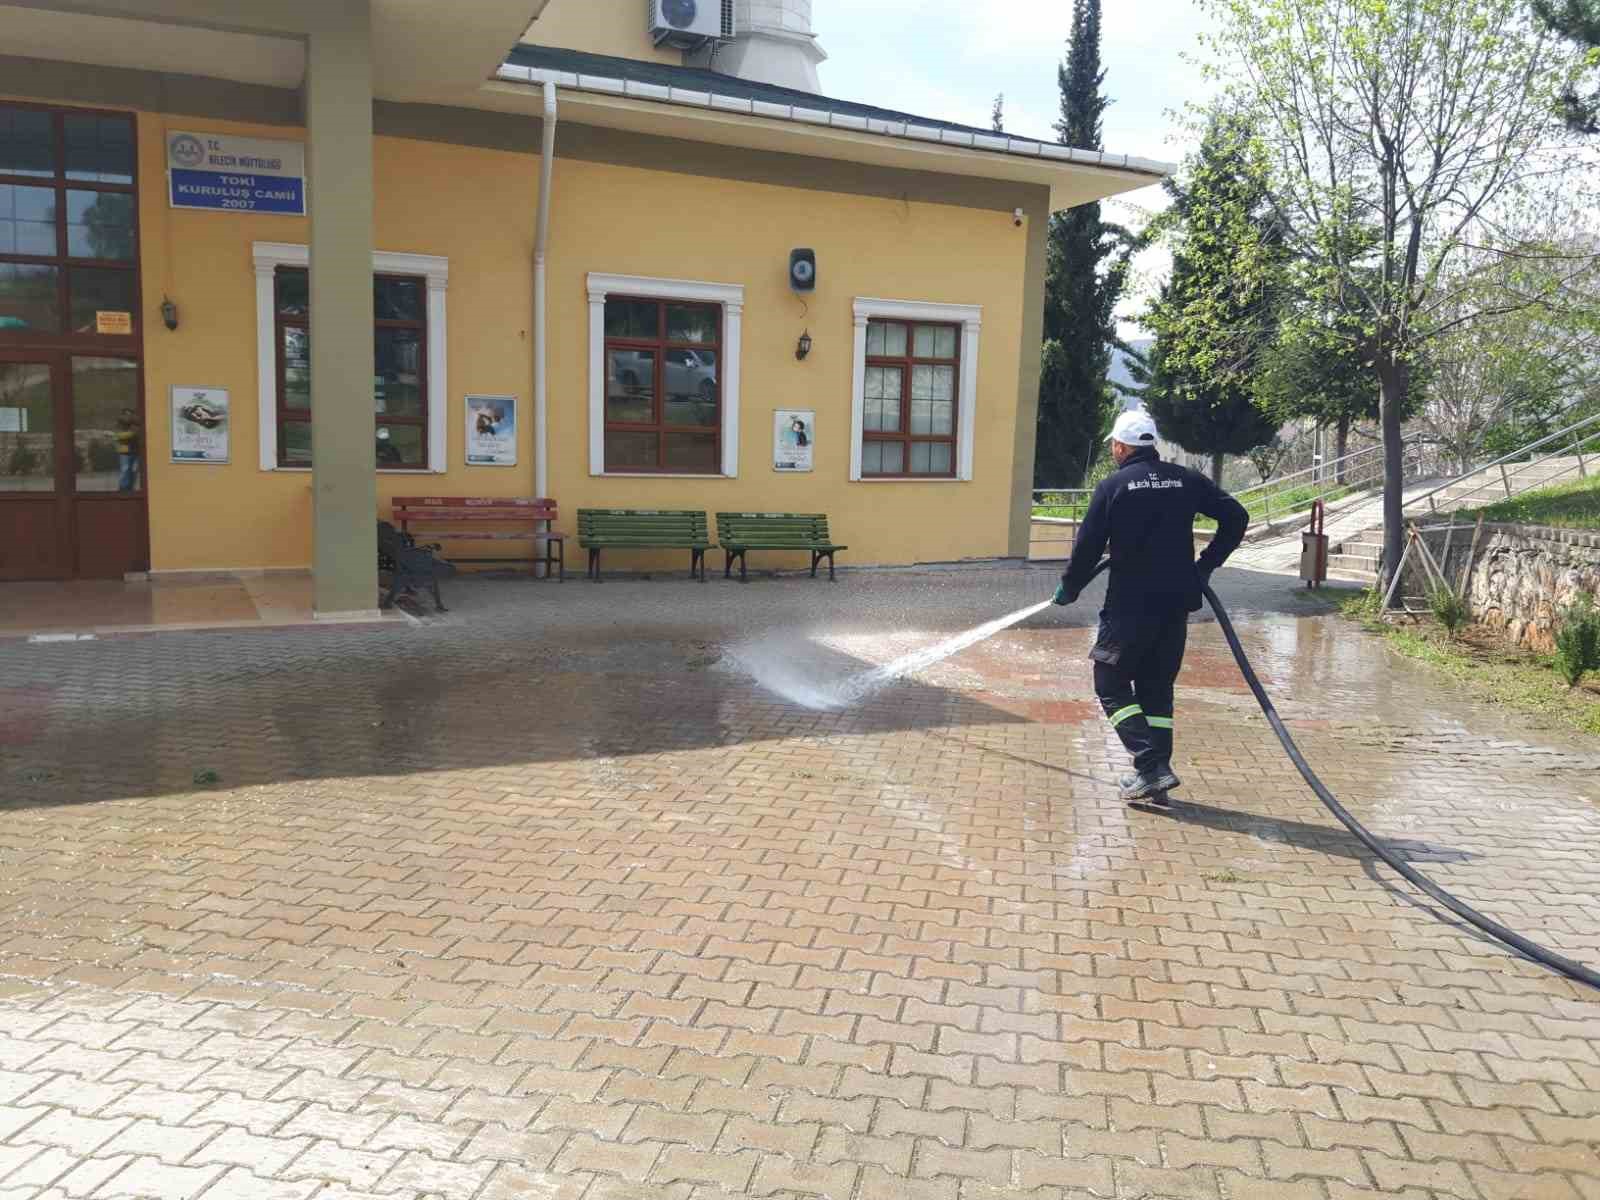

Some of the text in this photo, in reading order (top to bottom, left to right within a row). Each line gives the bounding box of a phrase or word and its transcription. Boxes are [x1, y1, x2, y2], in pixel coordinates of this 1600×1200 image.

[220, 175, 256, 187] TOKİ
[178, 184, 296, 201] KURULUŞ CAMİİ
[221, 200, 256, 209] 2007
